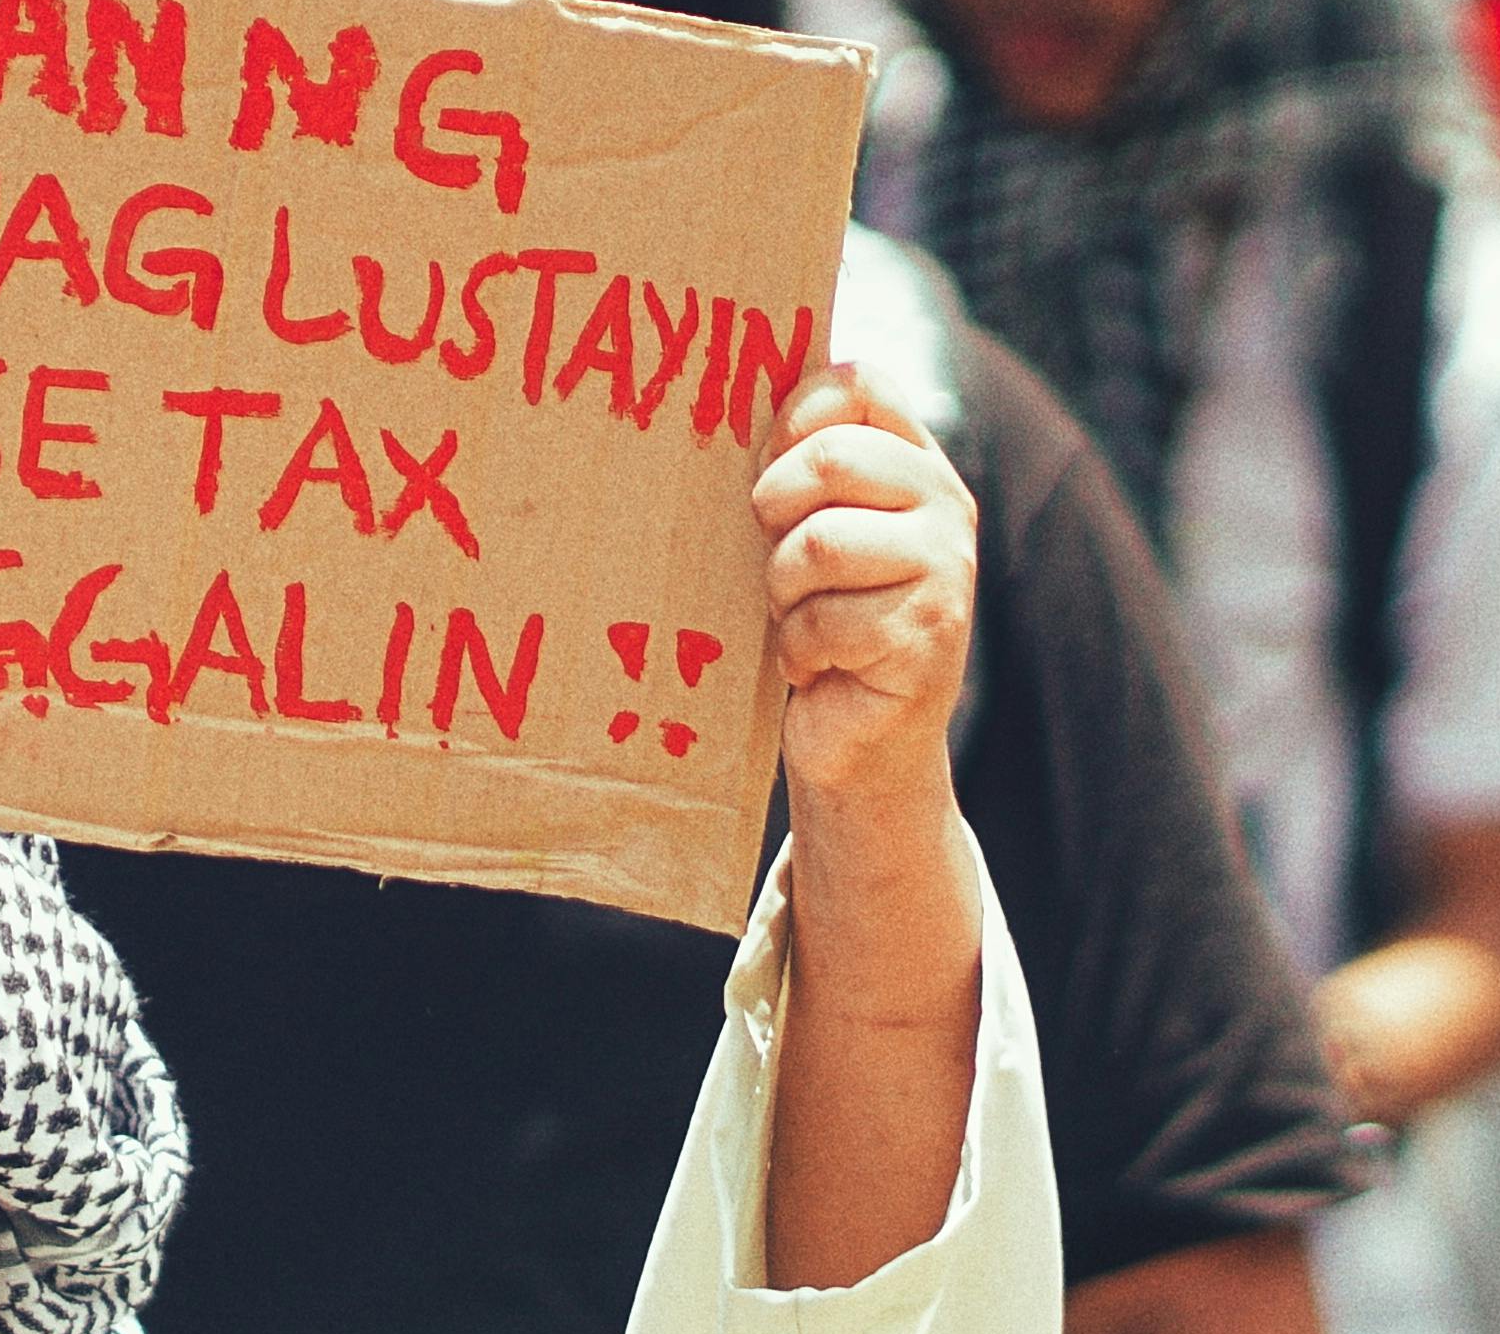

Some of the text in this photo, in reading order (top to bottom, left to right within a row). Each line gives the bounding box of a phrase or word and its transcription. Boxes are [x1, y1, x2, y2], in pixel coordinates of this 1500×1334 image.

[228, 18, 530, 215] NG
[263, 207, 814, 448] LUSTAYIN
[162, 387, 480, 560] TAX
